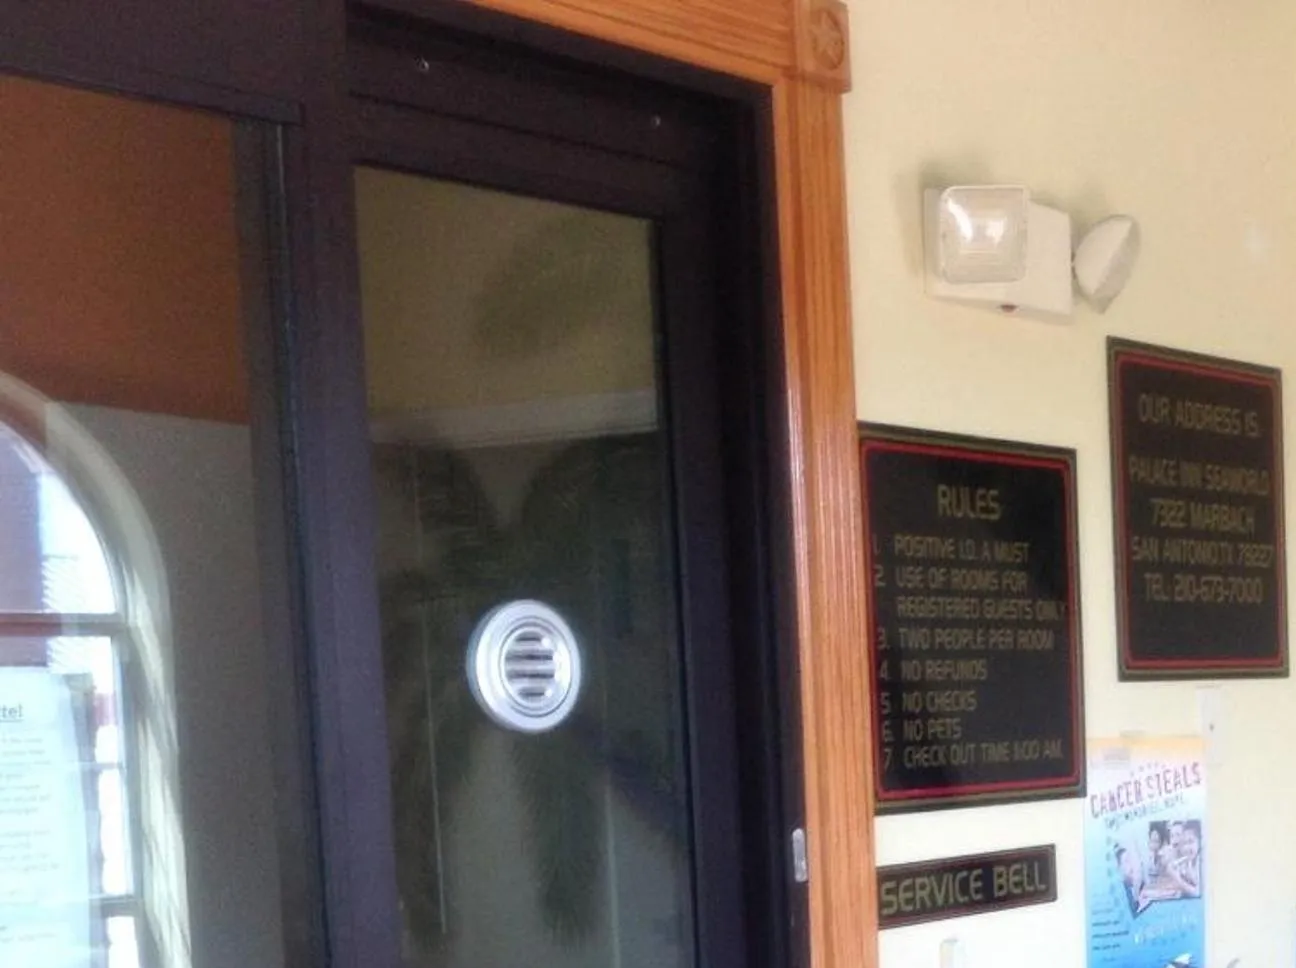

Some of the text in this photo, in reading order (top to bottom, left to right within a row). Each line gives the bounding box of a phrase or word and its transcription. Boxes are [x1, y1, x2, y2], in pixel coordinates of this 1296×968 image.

[1138, 392, 1170, 424] OUR
[1174, 399, 1241, 435] ADDRESS
[937, 484, 1001, 520] RULES
[894, 535, 956, 559] POSITIVE
[981, 541, 991, 562] A
[994, 541, 1030, 563] MUST
[1132, 535, 1159, 564] SAN
[896, 566, 924, 588] USE
[928, 567, 948, 590] OF
[951, 567, 999, 591] ROOMS
[1002, 571, 1028, 592] FOR
[897, 595, 979, 619] REGISTERED
[982, 598, 1033, 620] GUESTS
[899, 628, 930, 650] TWO
[934, 628, 985, 650] PEOPLE
[988, 629, 1015, 650] PER
[1016, 629, 1056, 651] ROOM
[901, 660, 921, 681] NO
[925, 659, 988, 681] REFUNDS
[902, 691, 922, 713] NO
[926, 690, 977, 713] CHECKS
[902, 720, 924, 741] NO
[927, 717, 962, 741] PETS
[903, 744, 948, 770] CHECK
[950, 742, 977, 766] OUT
[980, 741, 1010, 763] TIME
[1090, 778, 1143, 819] CANCER
[1146, 761, 1202, 798] STEALS
[880, 860, 1048, 916] SERVICE BELL
